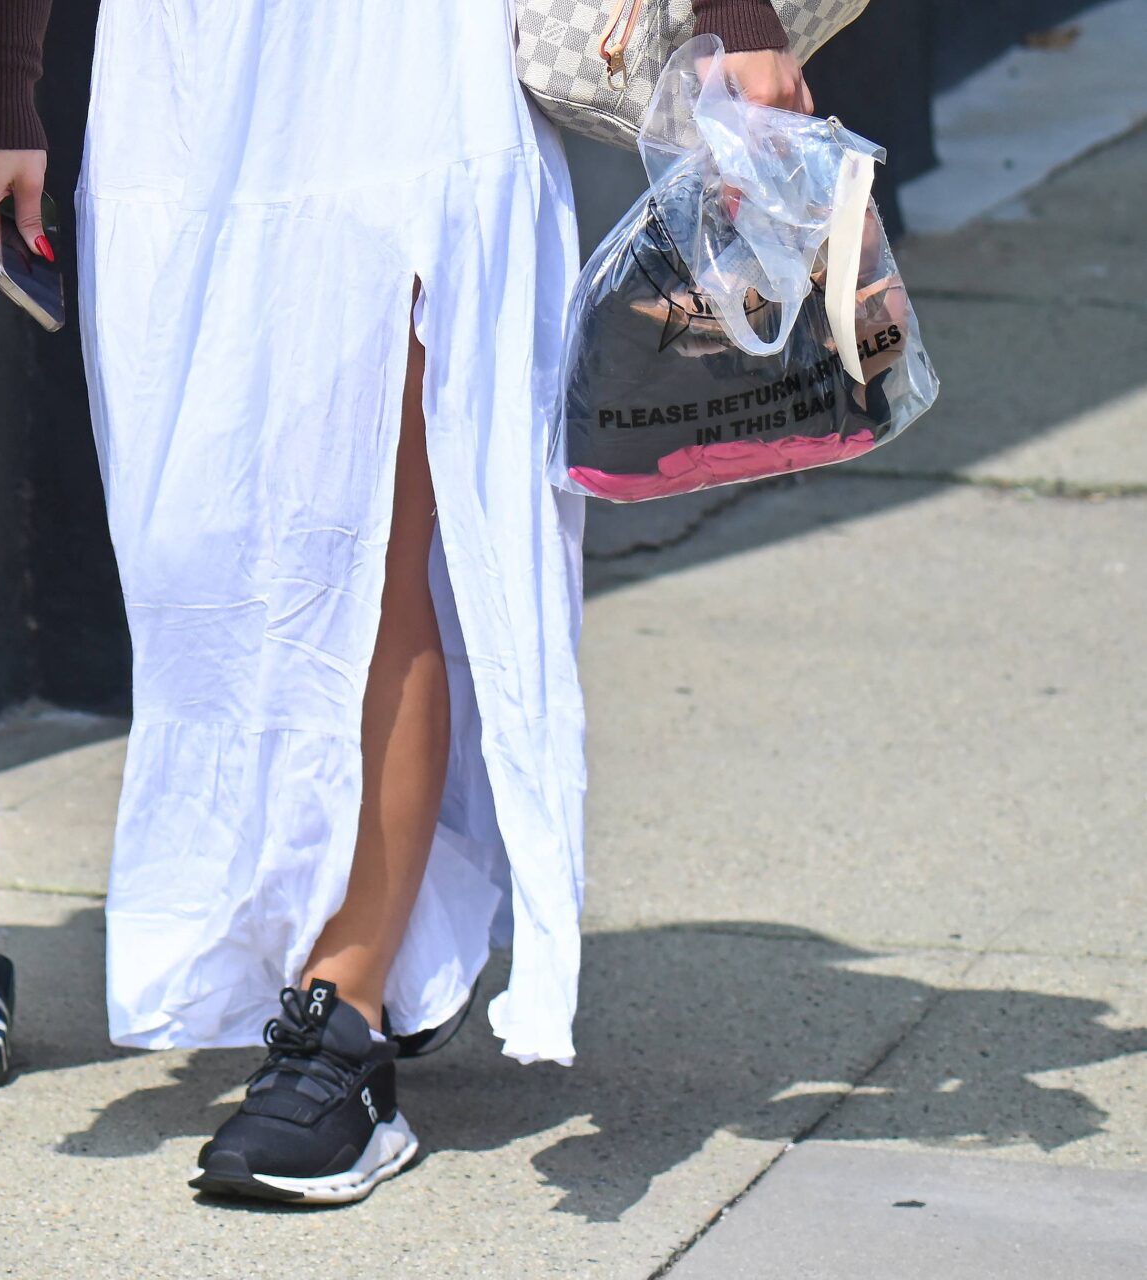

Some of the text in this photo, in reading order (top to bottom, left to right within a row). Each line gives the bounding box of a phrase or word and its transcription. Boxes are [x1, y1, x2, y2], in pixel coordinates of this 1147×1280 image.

[599, 403, 698, 429] PLEASE
[707, 373, 801, 418] RETURN
[696, 425, 722, 446] IN
[731, 410, 788, 438] THIS
